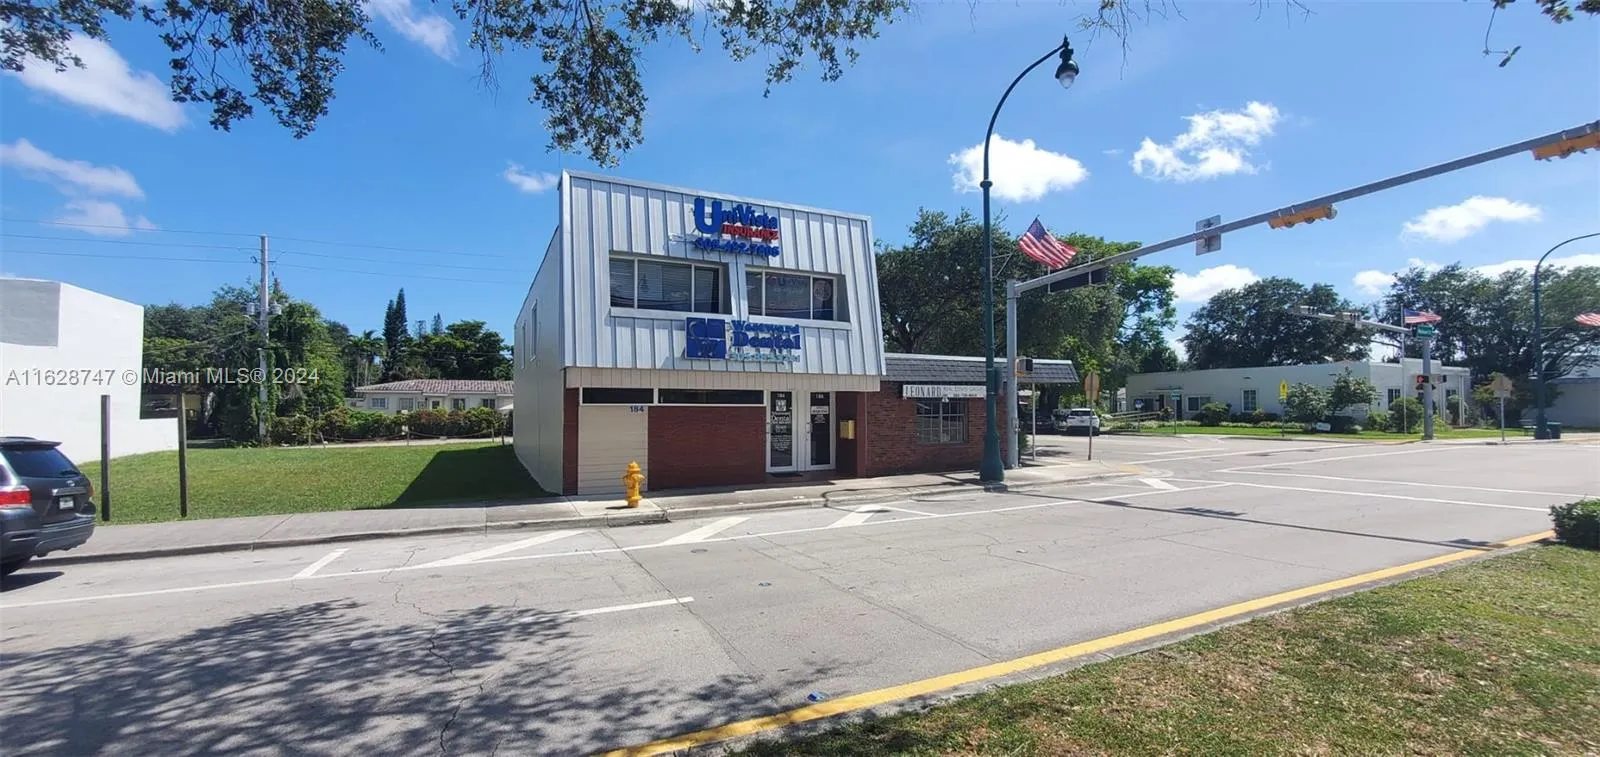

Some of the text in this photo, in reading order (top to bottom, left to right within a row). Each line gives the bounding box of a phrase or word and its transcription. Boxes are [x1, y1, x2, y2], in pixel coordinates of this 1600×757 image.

[722, 224, 779, 240] INSURANCE
[732, 331, 801, 350] Dental
[905, 385, 942, 397] LEONARD
